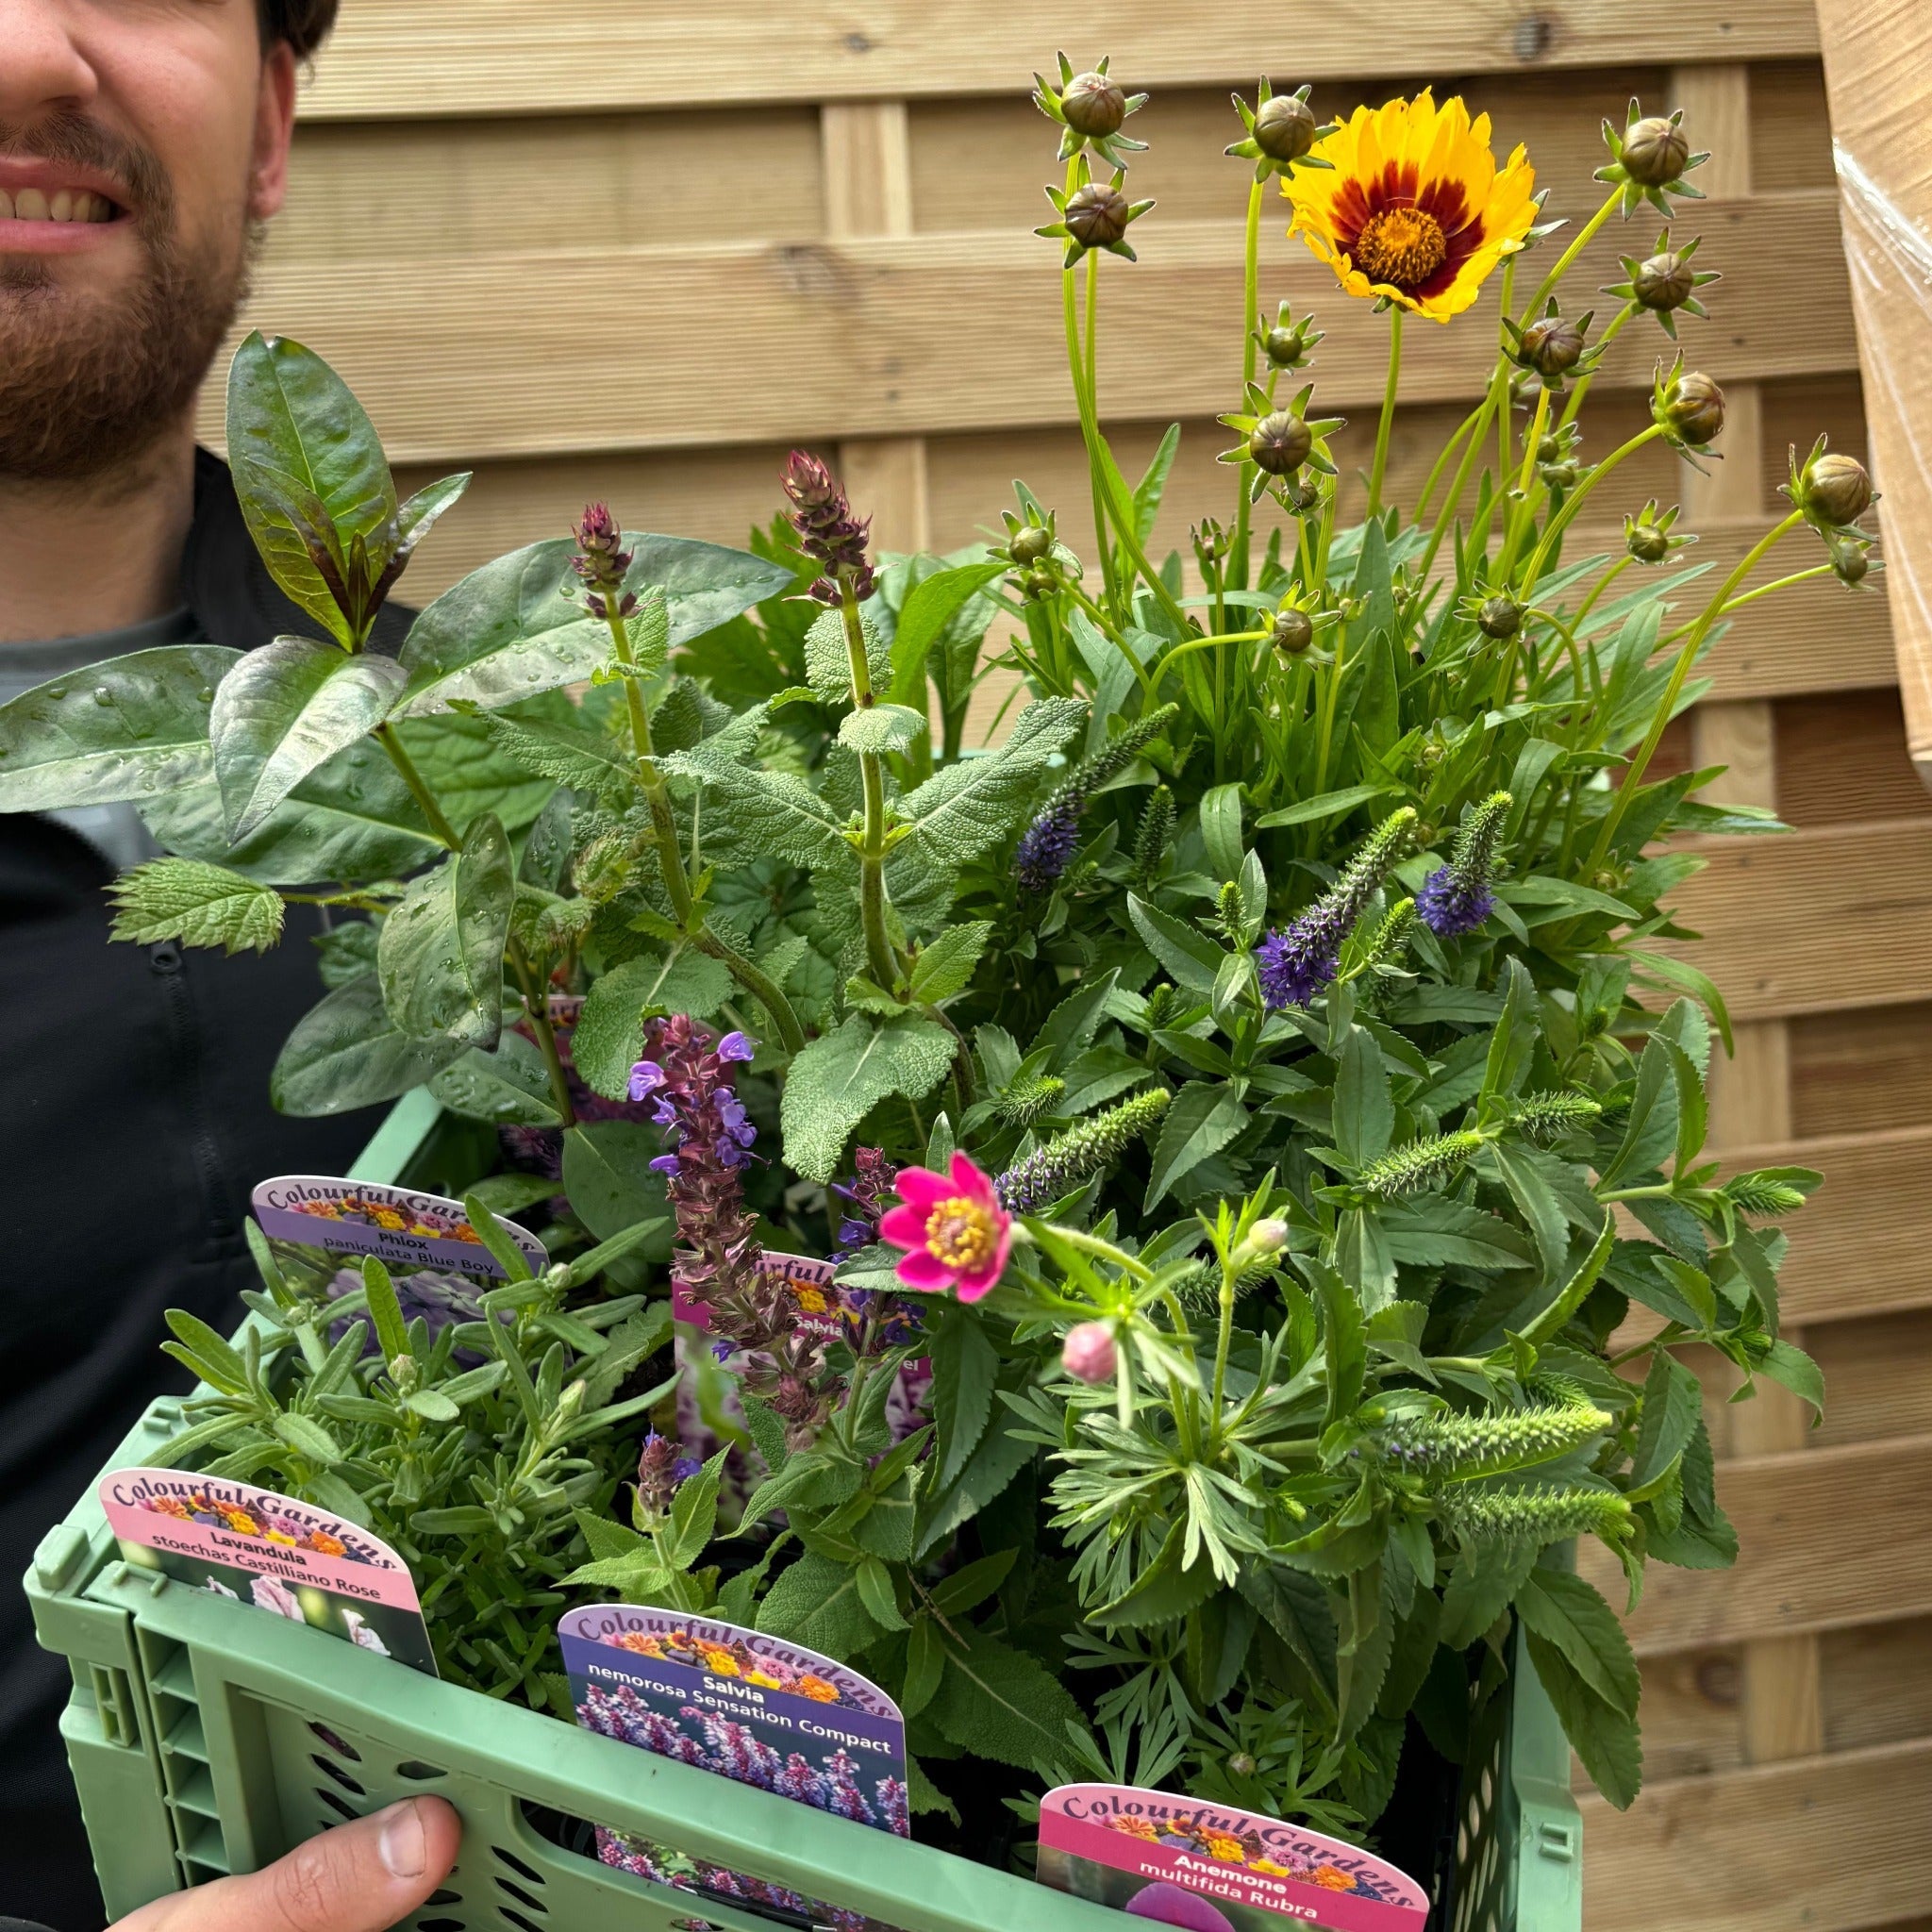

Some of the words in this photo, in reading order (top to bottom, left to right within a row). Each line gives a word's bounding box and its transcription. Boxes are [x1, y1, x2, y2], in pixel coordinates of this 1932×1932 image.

[267, 1184, 396, 1209] Colourful
[324, 1237, 412, 1260] paniculata
[418, 1252, 455, 1267] Blue
[461, 1259, 493, 1274] Boy
[378, 1232, 429, 1250] Phlox
[113, 1478, 244, 1507] Colourful
[257, 1495, 396, 1570] Gardens
[153, 1534, 229, 1562] stoechas
[235, 1554, 330, 1587] Castilliano
[336, 1577, 380, 1599] Rose
[211, 1532, 307, 1565] Lavandula
[577, 1612, 732, 1644] Colourful
[745, 1635, 892, 1718] Gardens
[589, 1662, 687, 1698] nemorosa
[693, 1690, 791, 1727] Sensation
[798, 1720, 891, 1755] Compact
[704, 1676, 764, 1704] Salvia
[1063, 1795, 1246, 1832] Colourful
[1261, 1826, 1415, 1907] Gardens
[1174, 1855, 1287, 1893] Anemone
[1141, 1861, 1241, 1899] multifida
[1249, 1891, 1317, 1919] Rubra
